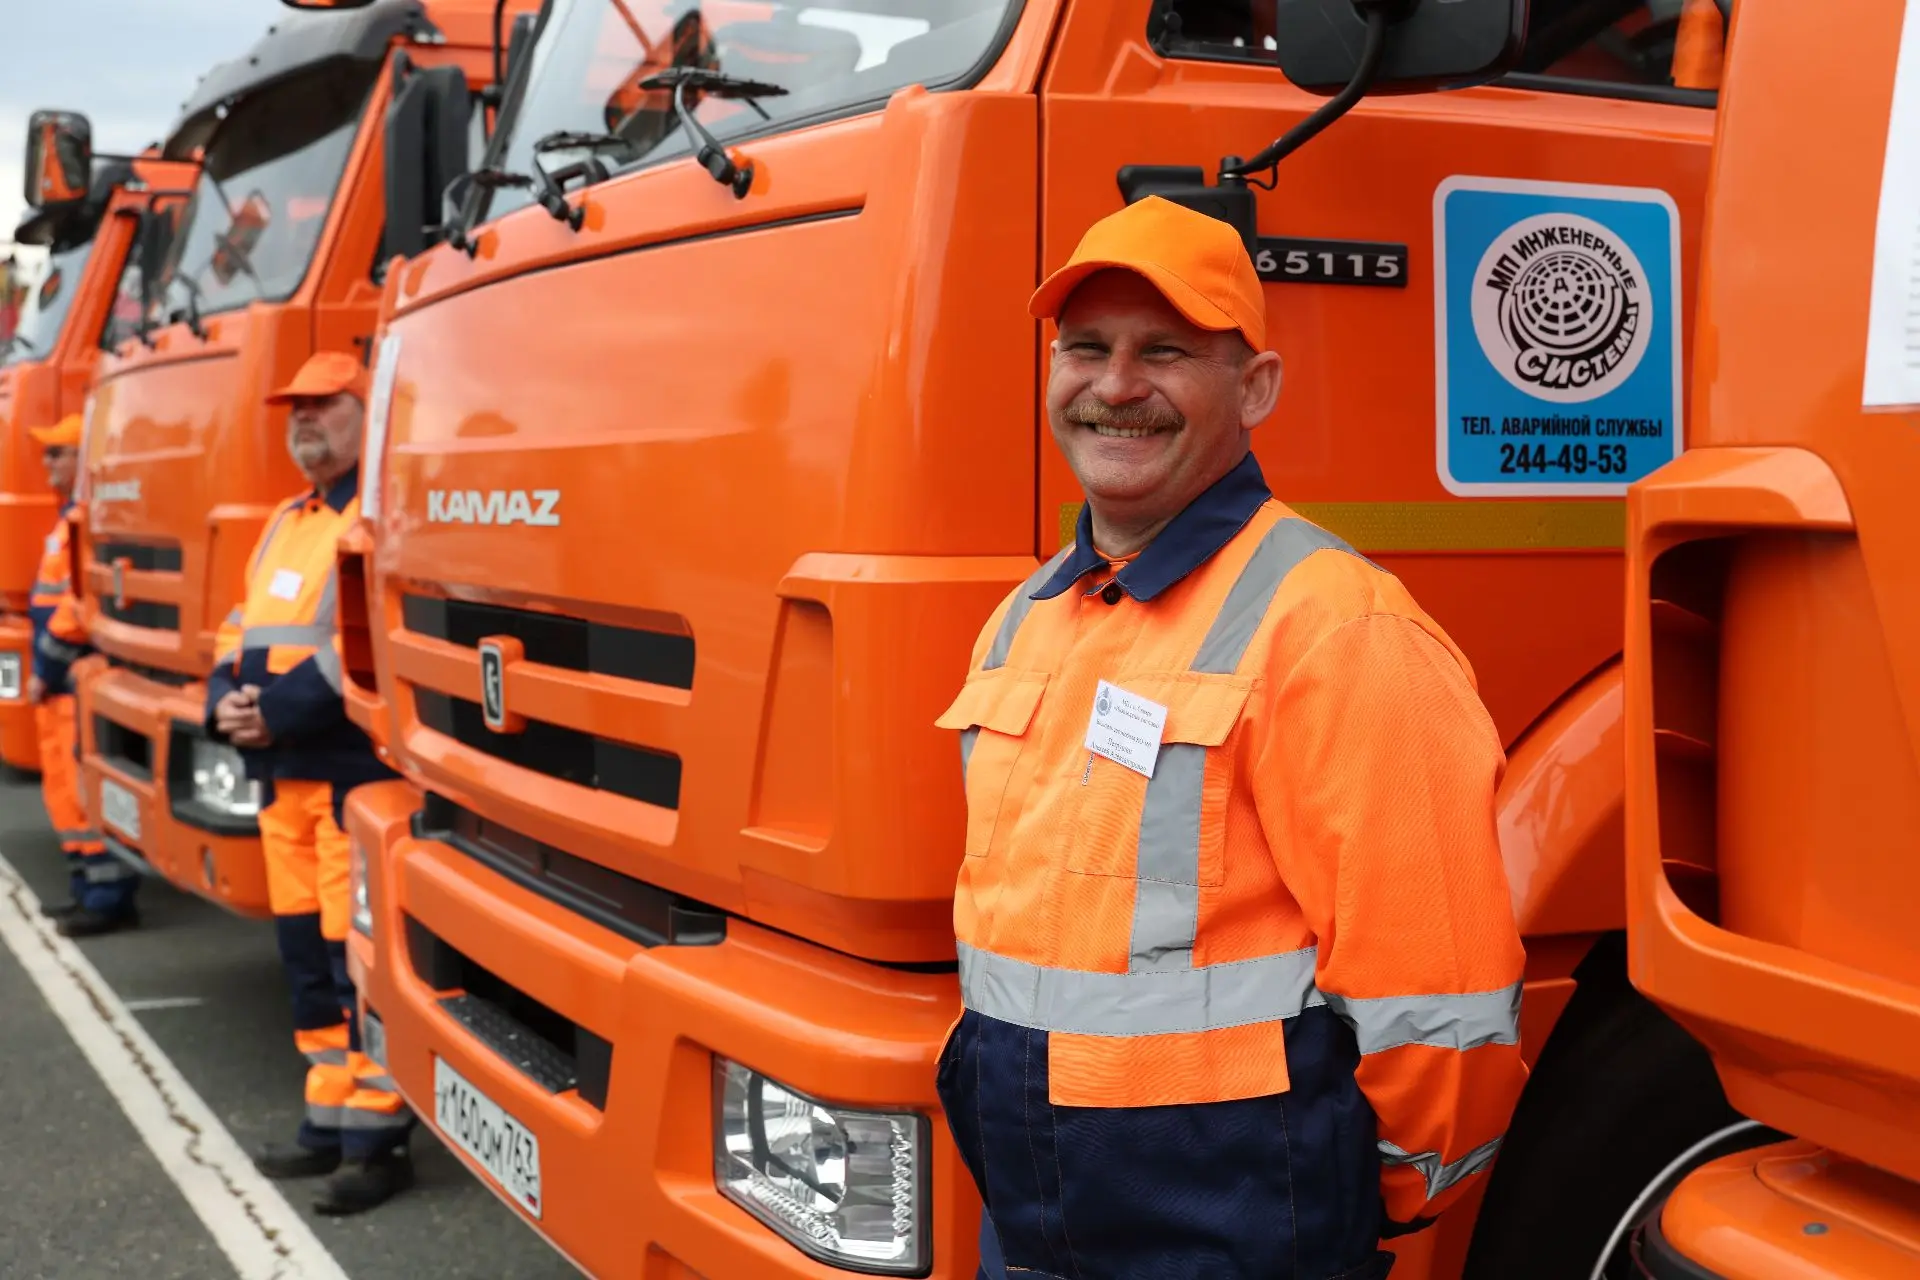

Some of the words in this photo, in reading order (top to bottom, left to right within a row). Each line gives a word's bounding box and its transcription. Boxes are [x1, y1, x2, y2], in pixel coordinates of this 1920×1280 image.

[1255, 249, 1400, 279] 65115
[1486, 253, 1521, 293] МП
[1512, 226, 1637, 290] ИНЖЕНЕРНЫЕ
[1514, 302, 1639, 389] СИСТЕМЫ
[1461, 416, 1496, 436] ТЕЛ.
[1501, 413, 1591, 437] АВАРИЙНОЙ
[1595, 417, 1663, 438] СЛУЖБЫ
[1499, 442, 1628, 475] 244-49-53
[427, 489, 561, 526] KAMAZ
